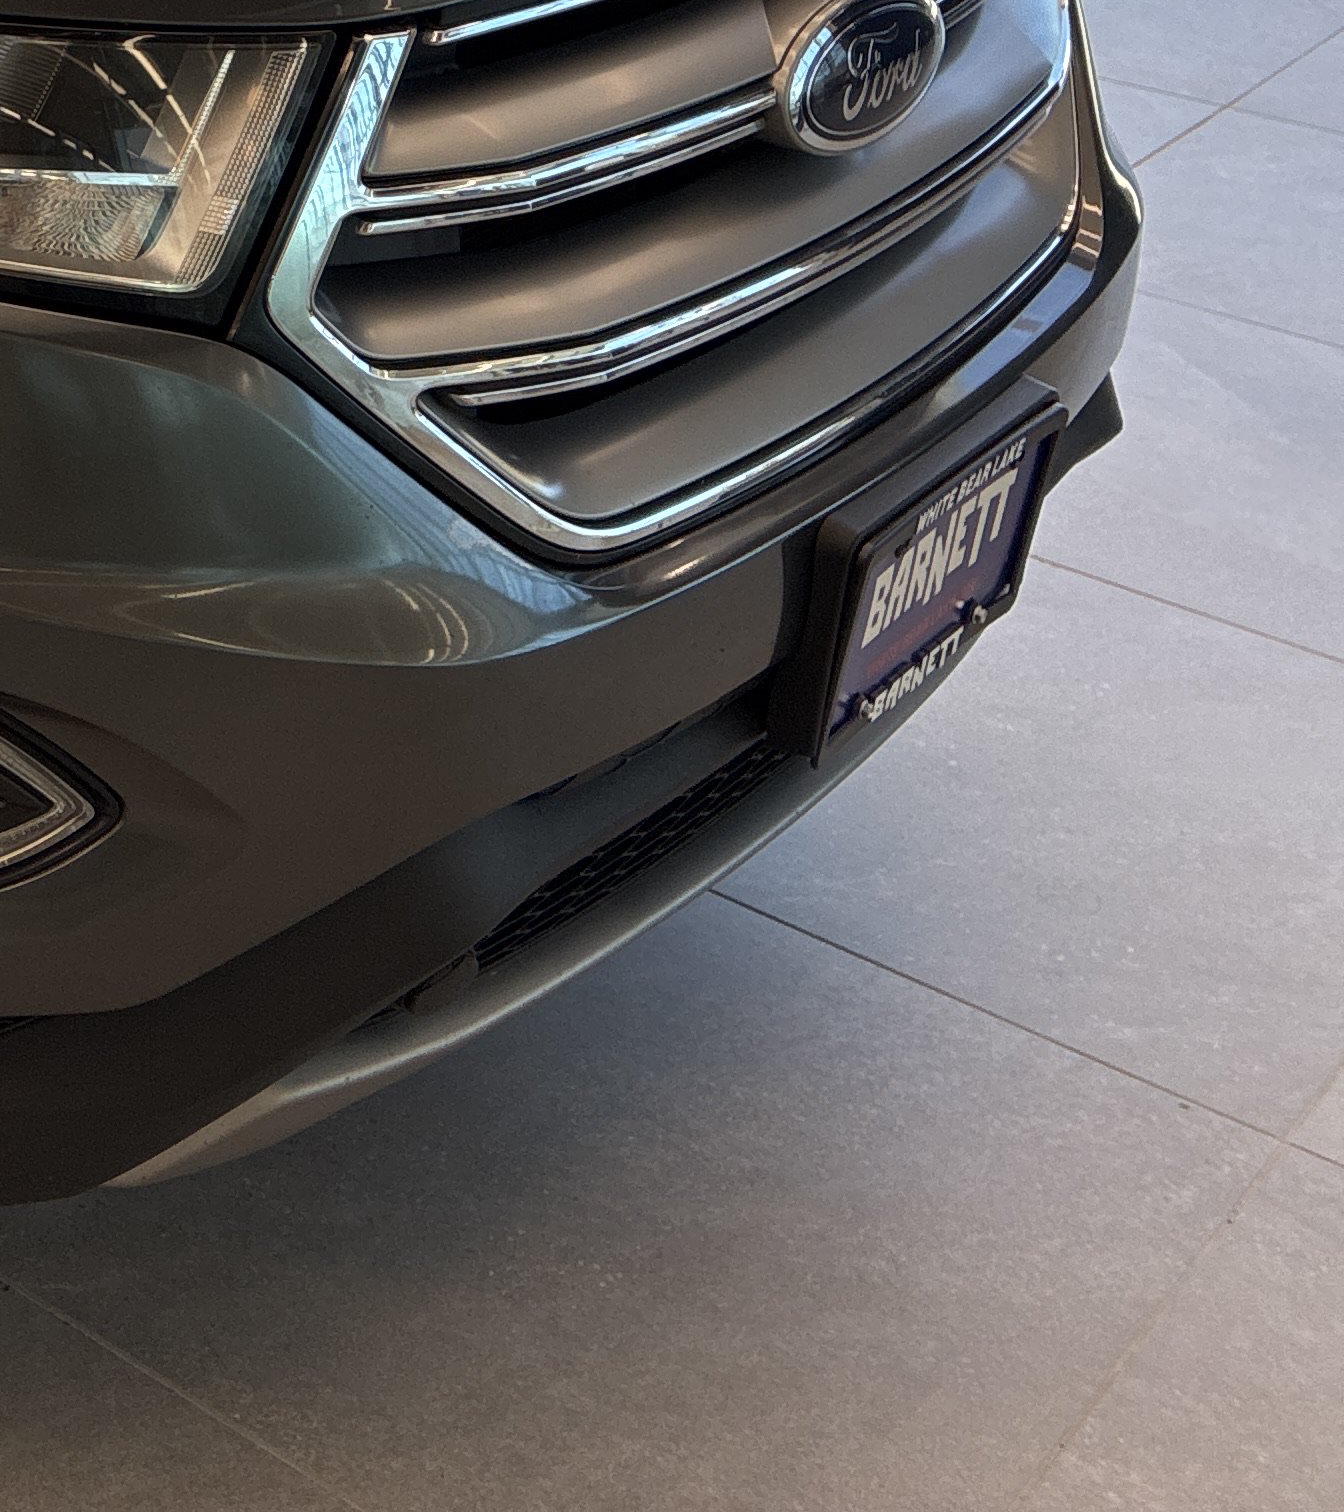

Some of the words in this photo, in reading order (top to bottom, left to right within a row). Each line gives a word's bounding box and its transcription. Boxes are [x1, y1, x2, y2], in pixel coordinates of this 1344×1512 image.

[842, 22, 922, 121] Ford
[915, 486, 959, 535] WHITE
[955, 461, 992, 505] BEAR
[991, 437, 1026, 477] LAKE
[860, 467, 1018, 650] BARNETT
[870, 625, 965, 723] BARNETT
